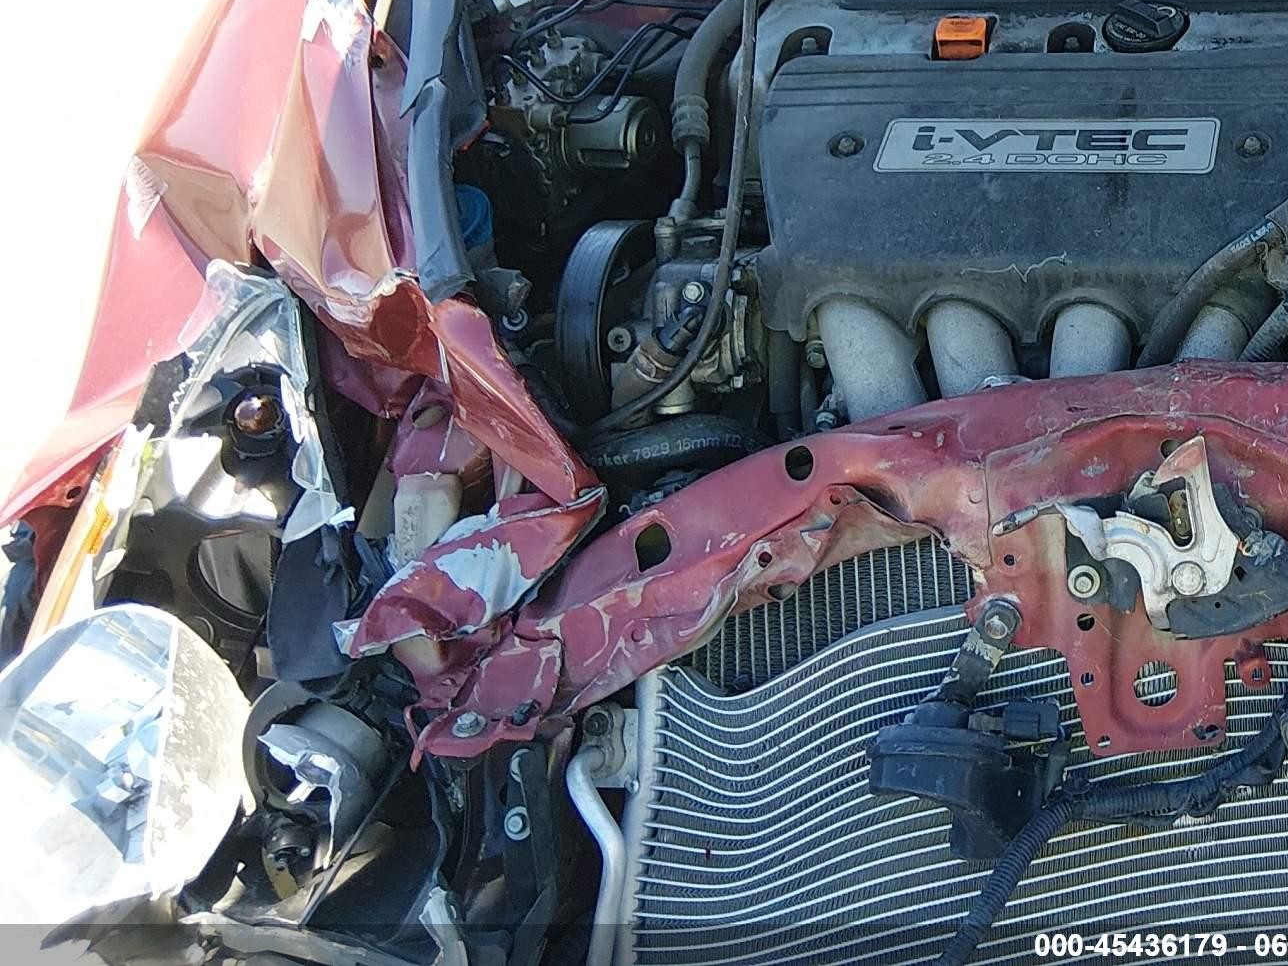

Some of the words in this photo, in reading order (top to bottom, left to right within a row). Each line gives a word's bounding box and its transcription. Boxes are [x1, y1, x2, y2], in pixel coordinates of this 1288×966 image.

[912, 126, 1189, 152] i-VTEC
[921, 152, 995, 166] 2.4
[1004, 152, 1169, 166] DOHC
